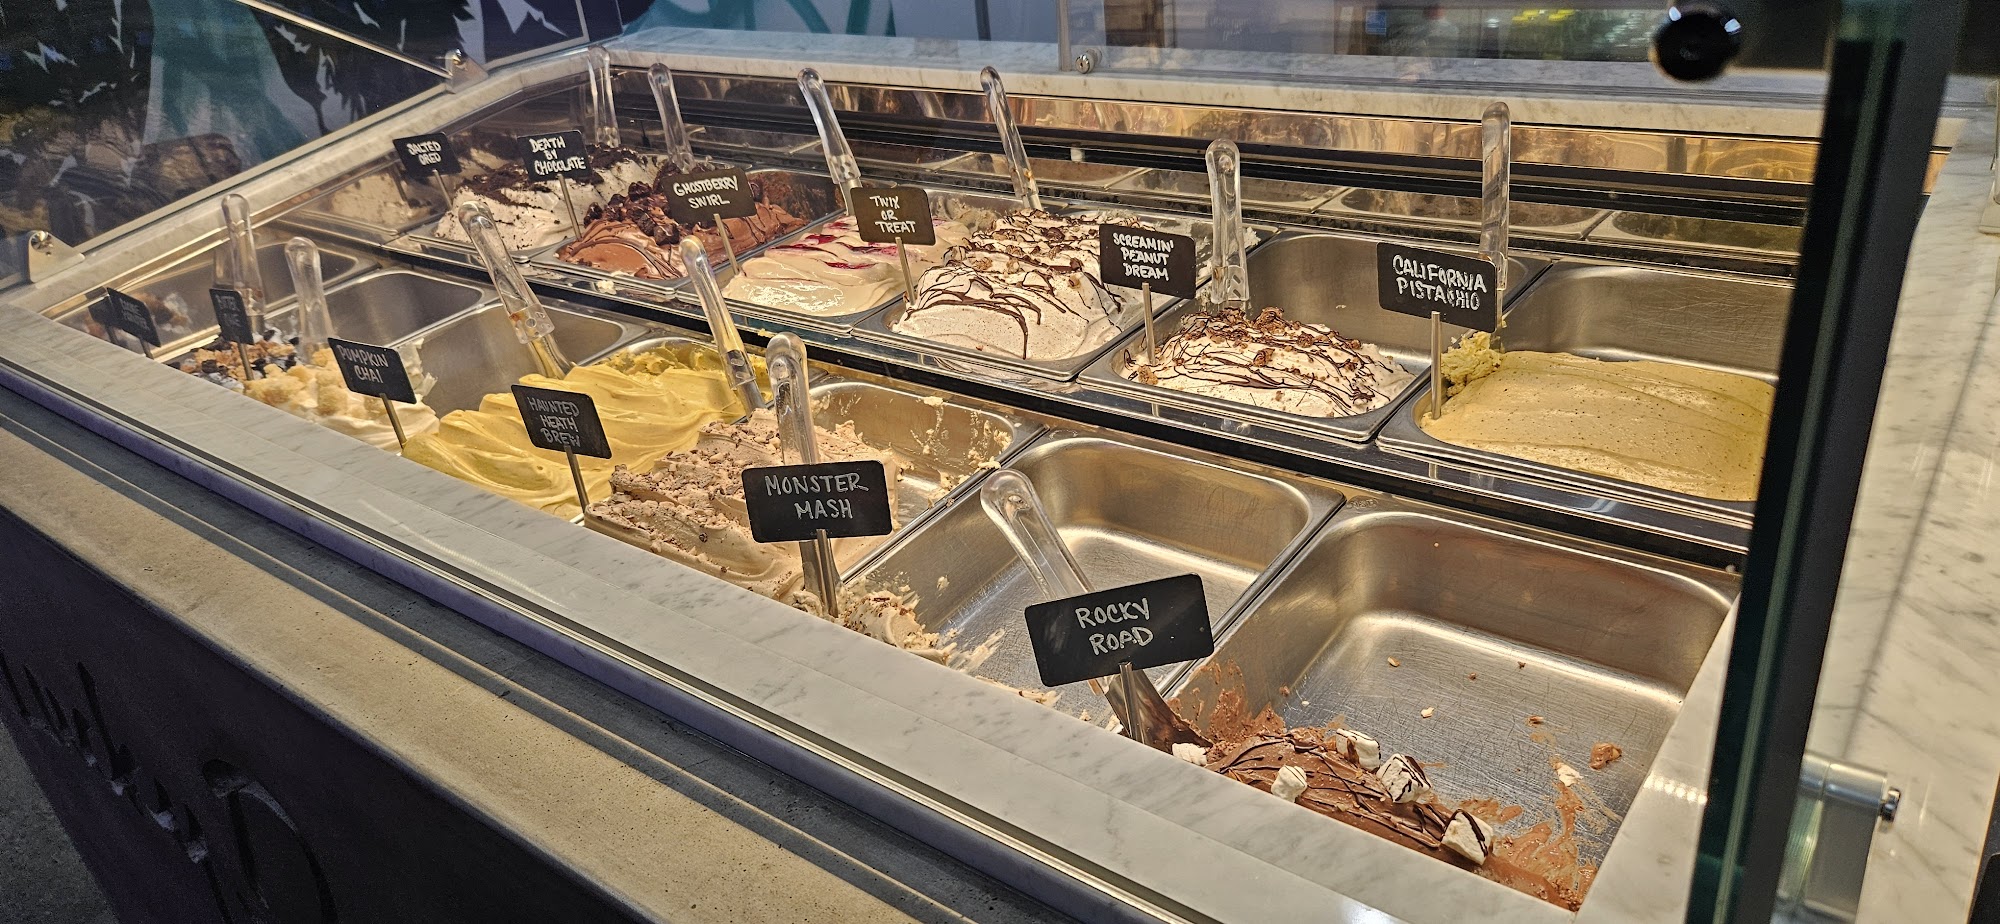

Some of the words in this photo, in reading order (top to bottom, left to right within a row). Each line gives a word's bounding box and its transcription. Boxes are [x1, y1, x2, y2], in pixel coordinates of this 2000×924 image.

[406, 141, 442, 156] SALTED
[529, 136, 566, 153] DEATH
[544, 149, 558, 161] BY
[534, 156, 587, 176] CHOCOLATE
[673, 175, 739, 197] GHOSTBERRY
[688, 193, 731, 209] SWIRL
[869, 195, 901, 210] TWIX
[880, 209, 899, 221] OR
[874, 220, 917, 234] TREAT
[1112, 232, 1175, 253] SCREAMIN'
[1120, 246, 1170, 266] PEANUT
[1122, 262, 1170, 282] DREAM
[1392, 254, 1488, 294] CALIFORNIA
[1396, 276, 1481, 311] PISTACHIO
[336, 344, 390, 369] PUMPKIN
[353, 364, 384, 384] CHAI
[526, 396, 580, 418] HAUNTED
[539, 414, 580, 433] HEATH
[540, 427, 581, 448] BREW
[764, 472, 870, 497] MONSTER
[793, 498, 854, 520] MASH
[1074, 597, 1151, 630] ROCKY
[1088, 626, 1155, 657] ROAD
